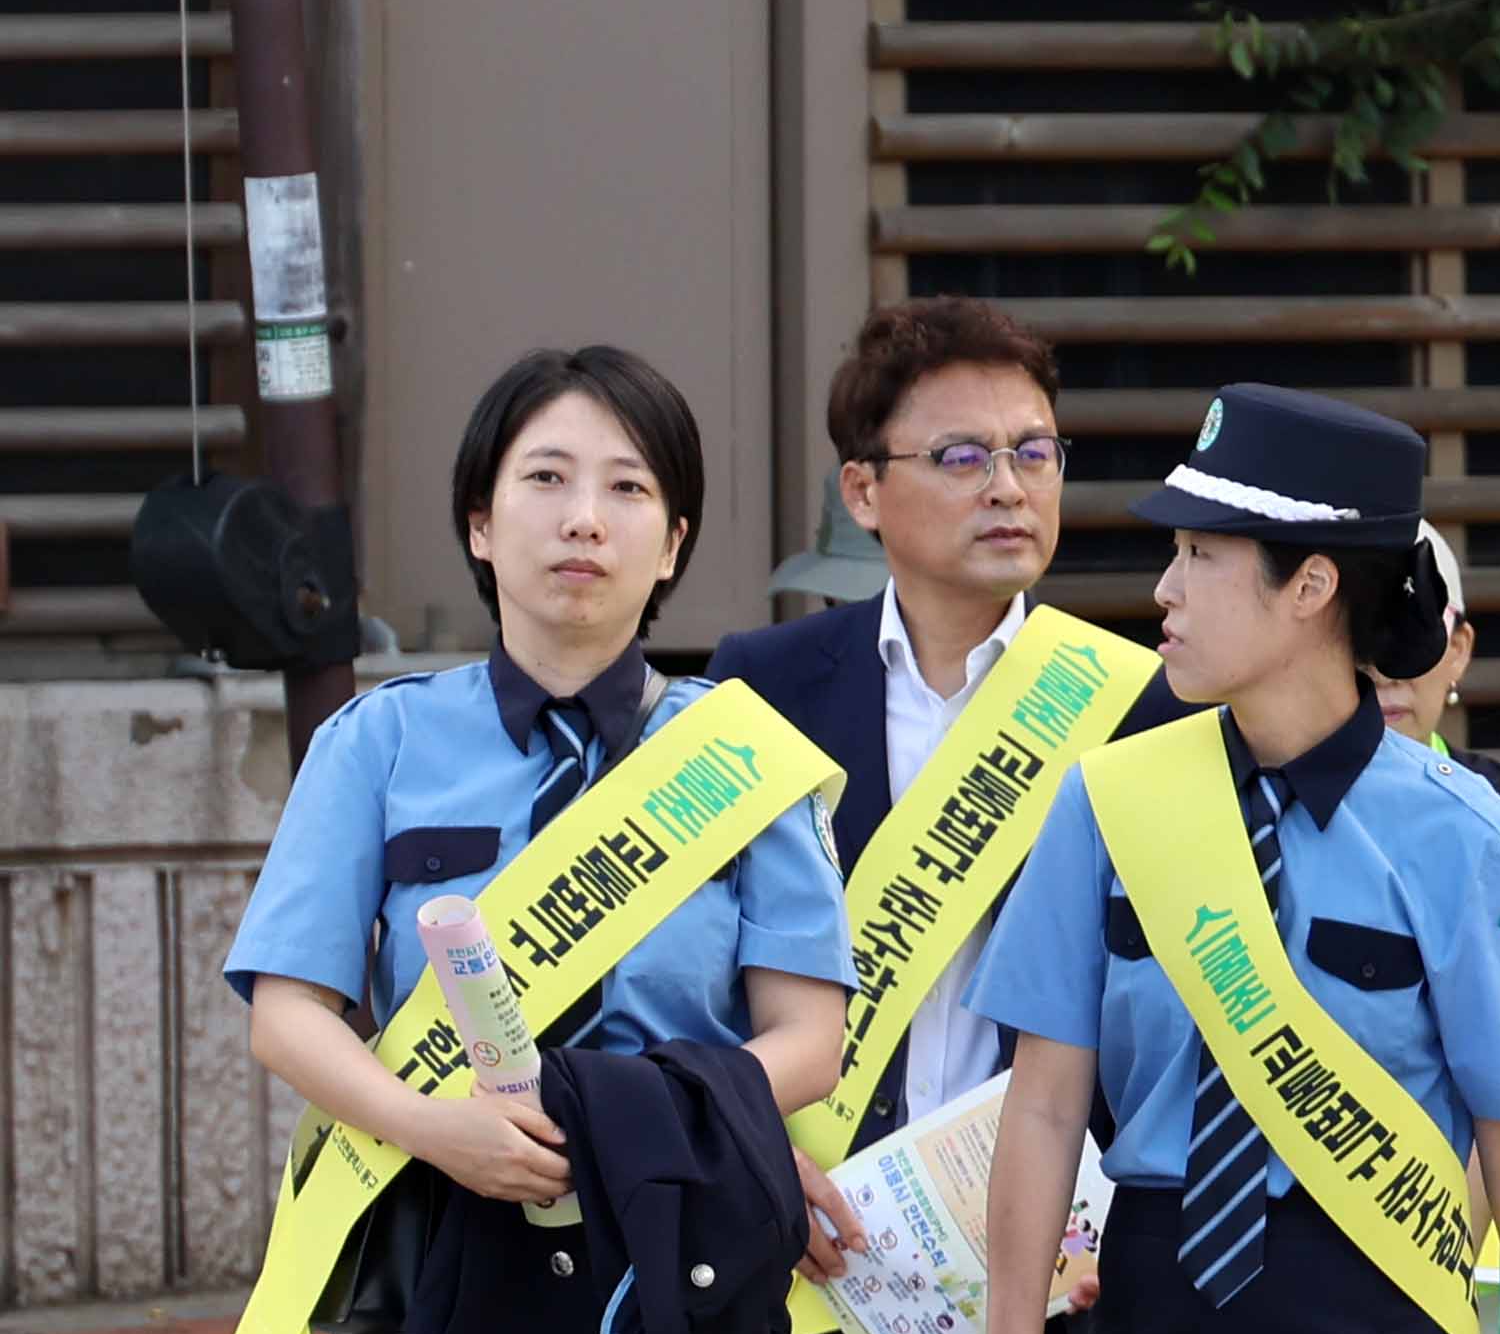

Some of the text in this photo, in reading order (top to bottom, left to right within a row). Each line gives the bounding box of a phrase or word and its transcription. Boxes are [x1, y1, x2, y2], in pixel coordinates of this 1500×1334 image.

[1012, 642, 1110, 749] 스쿨존
[508, 737, 763, 969] 스쿨존 교통법규
[913, 730, 1044, 885] 교통법규
[1185, 905, 1277, 1035] 스쿨존
[1250, 1023, 1398, 1182] 교통법규
